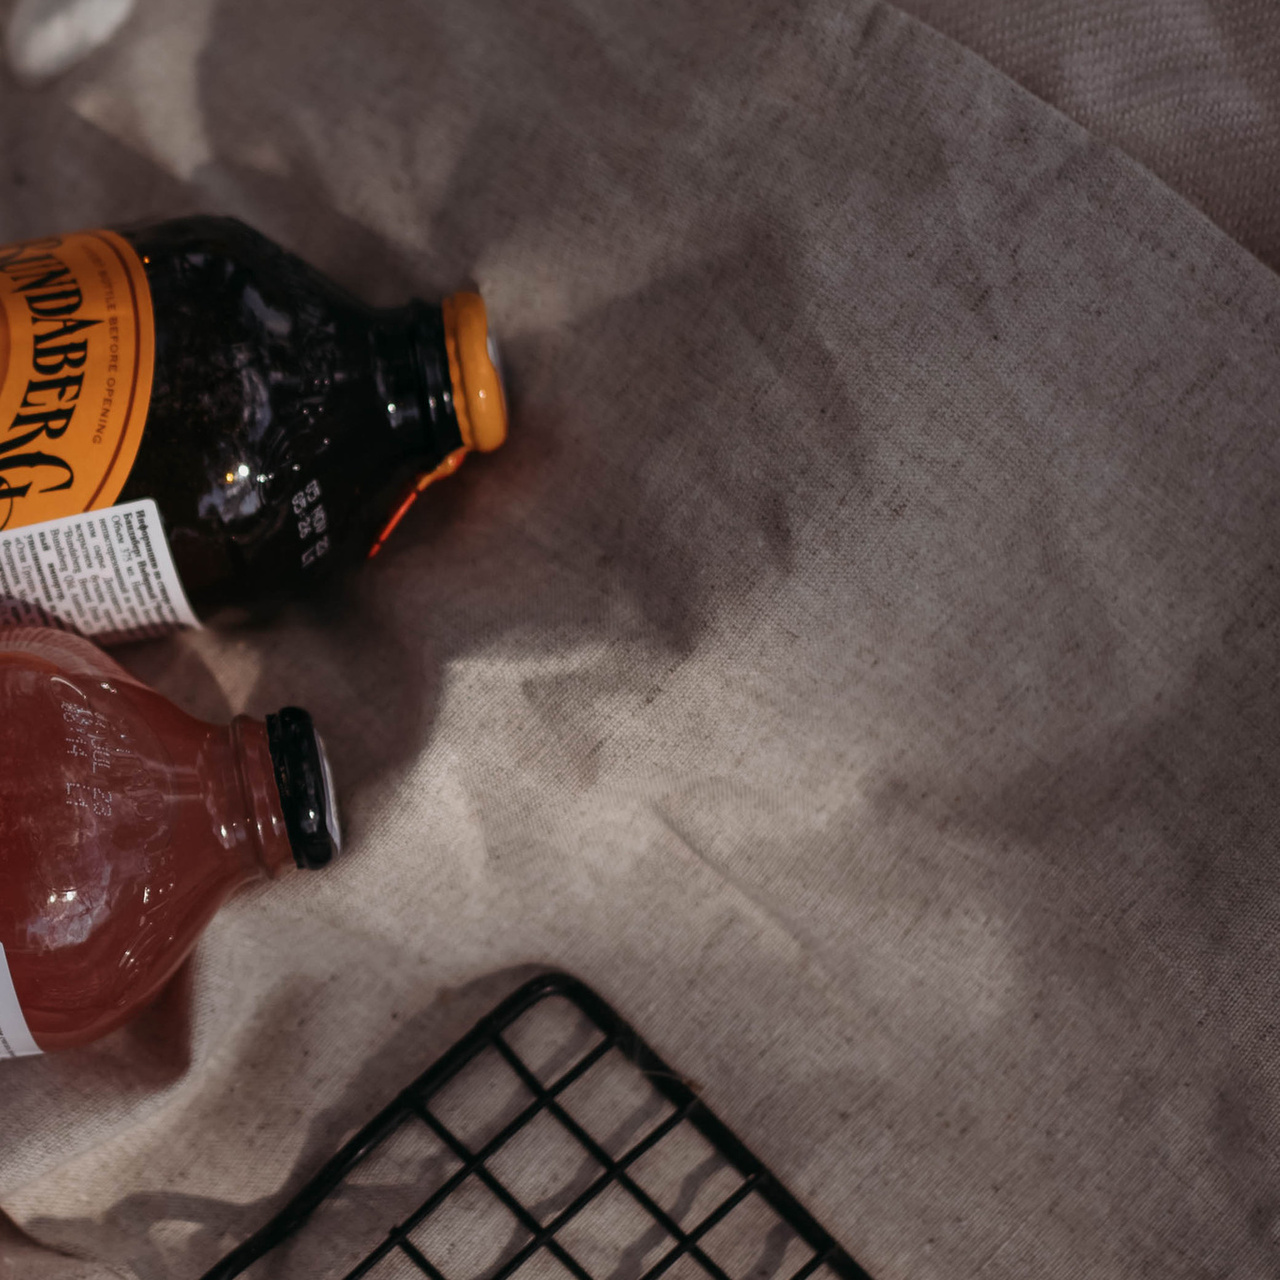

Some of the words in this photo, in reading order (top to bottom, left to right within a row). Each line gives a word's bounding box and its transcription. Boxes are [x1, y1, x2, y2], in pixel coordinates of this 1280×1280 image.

[108, 316, 117, 372] BEFORE
[91, 377, 115, 444] OPENING
[50, 528, 68, 572] Bundaberg
[123, 512, 142, 557] Бандаберг
[135, 510, 158, 569] Информацию
